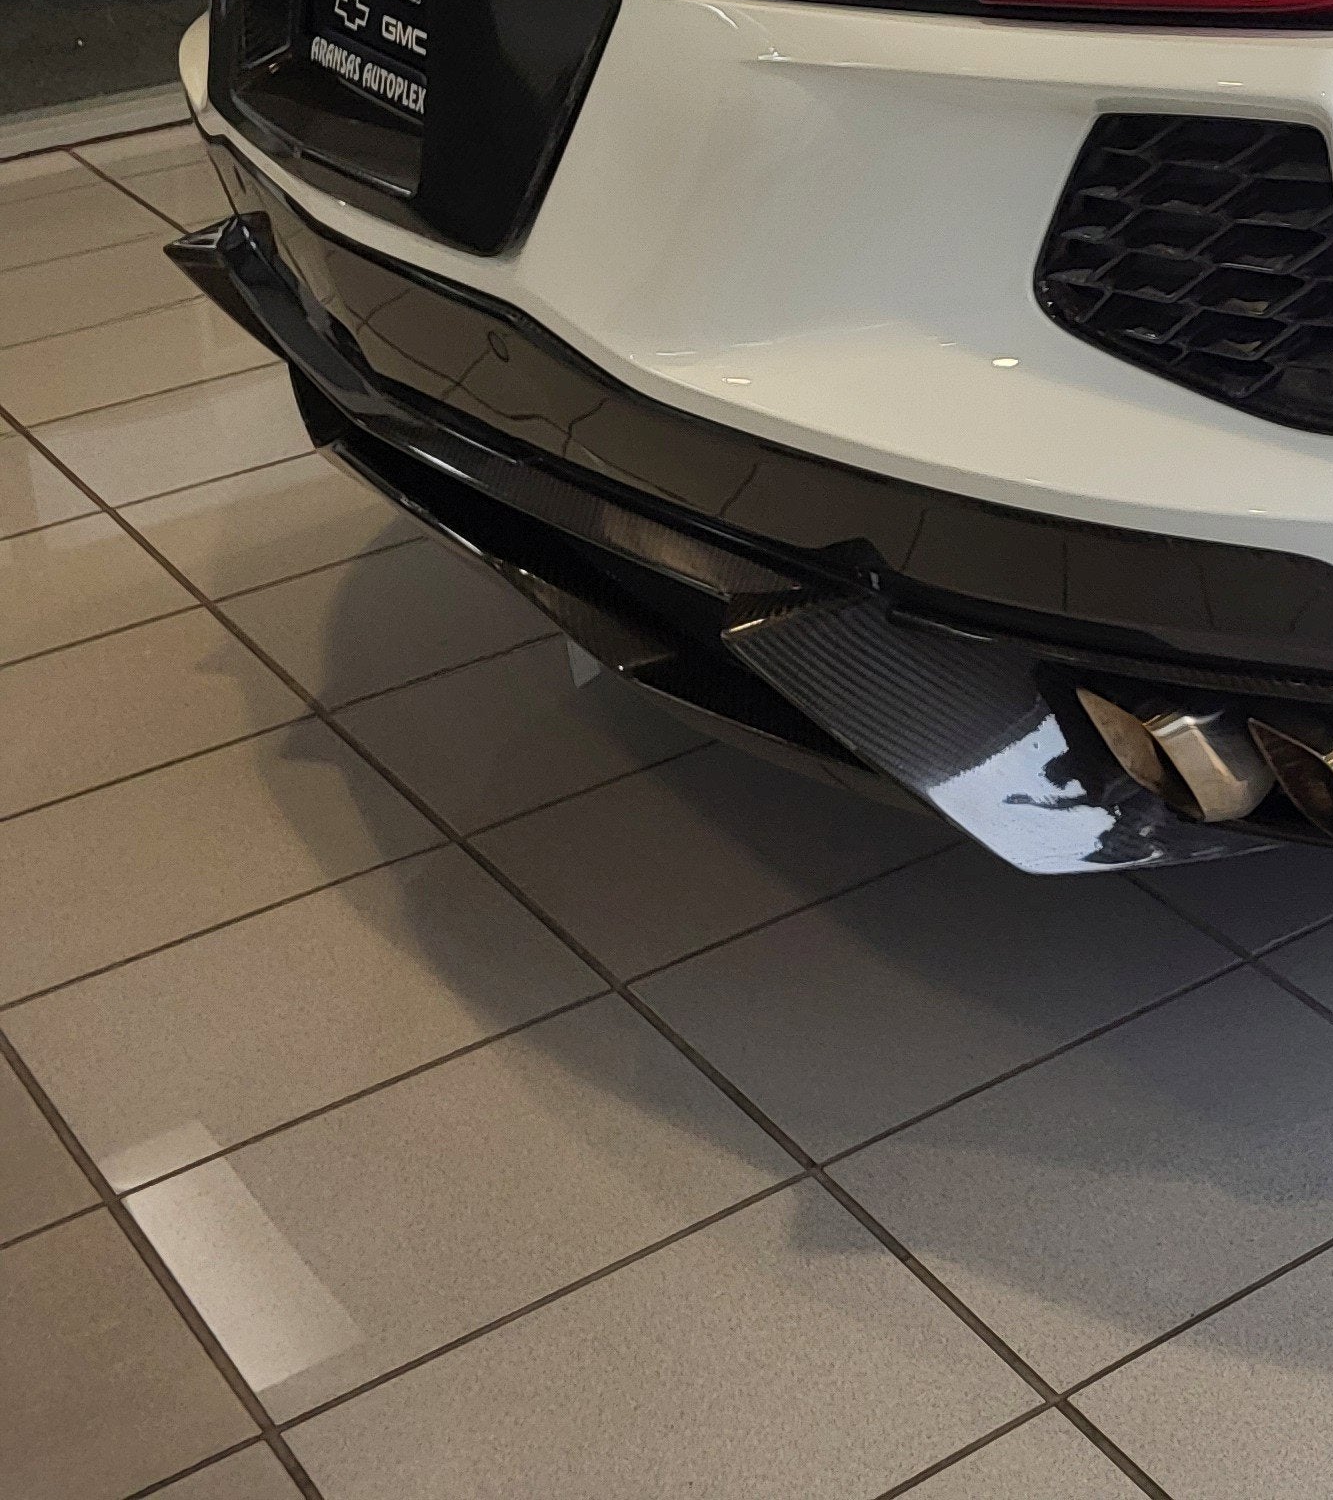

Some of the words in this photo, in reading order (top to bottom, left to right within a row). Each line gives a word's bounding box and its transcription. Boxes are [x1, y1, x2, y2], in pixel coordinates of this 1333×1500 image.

[382, 14, 428, 56] GMC
[310, 36, 361, 81] ARANSAS
[362, 62, 427, 115] AUTOPLEX
